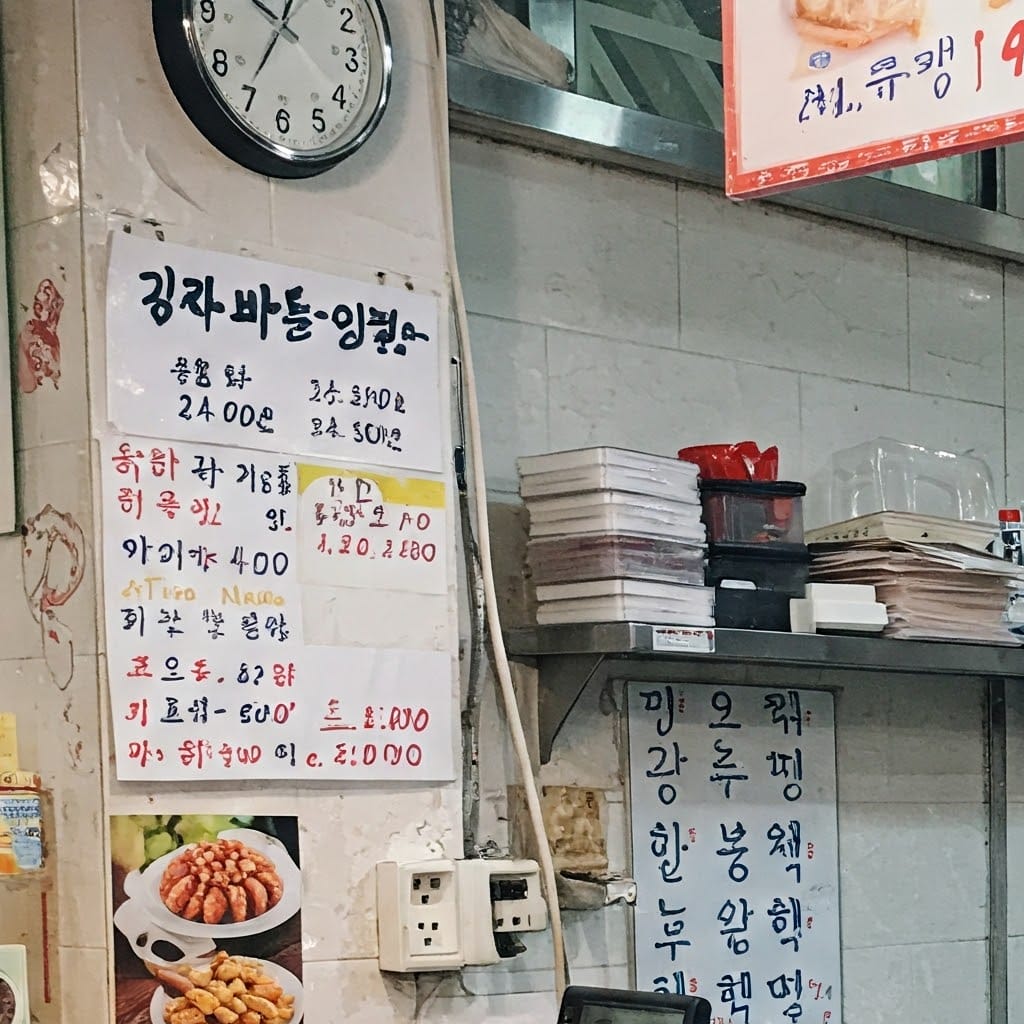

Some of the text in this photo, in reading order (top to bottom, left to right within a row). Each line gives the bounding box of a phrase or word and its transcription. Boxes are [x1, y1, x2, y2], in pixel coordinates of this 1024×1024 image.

[340, 8, 356, 33] 2
[212, 49, 227, 77] 8
[345, 48, 358, 72] 3
[241, 84, 256, 111] 7
[332, 84, 346, 109] 4
[276, 109, 290, 133] 6
[312, 108, 325, 132] 5
